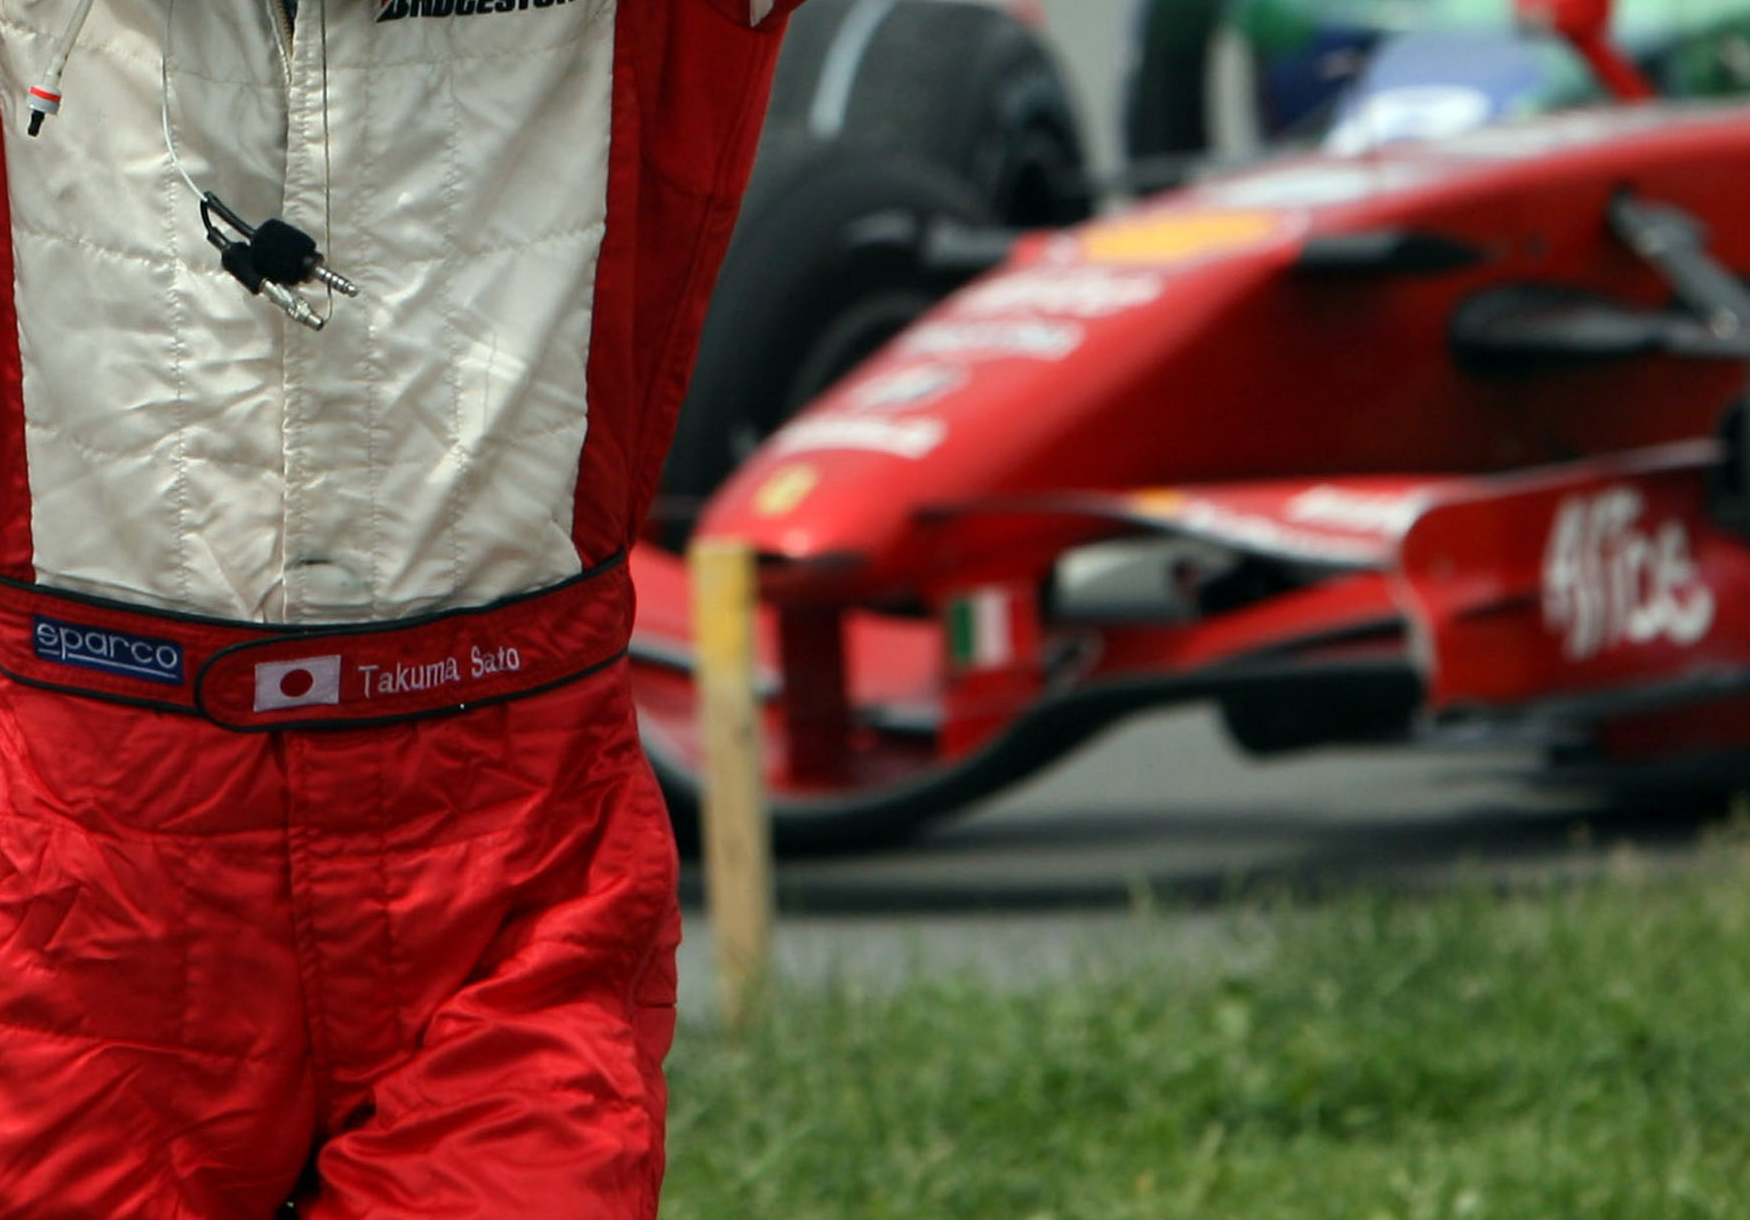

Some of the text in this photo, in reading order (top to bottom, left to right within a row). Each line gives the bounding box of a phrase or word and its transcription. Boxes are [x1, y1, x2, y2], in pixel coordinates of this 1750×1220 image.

[36, 623, 178, 672] sparco
[358, 645, 520, 699] Takuma Sato
